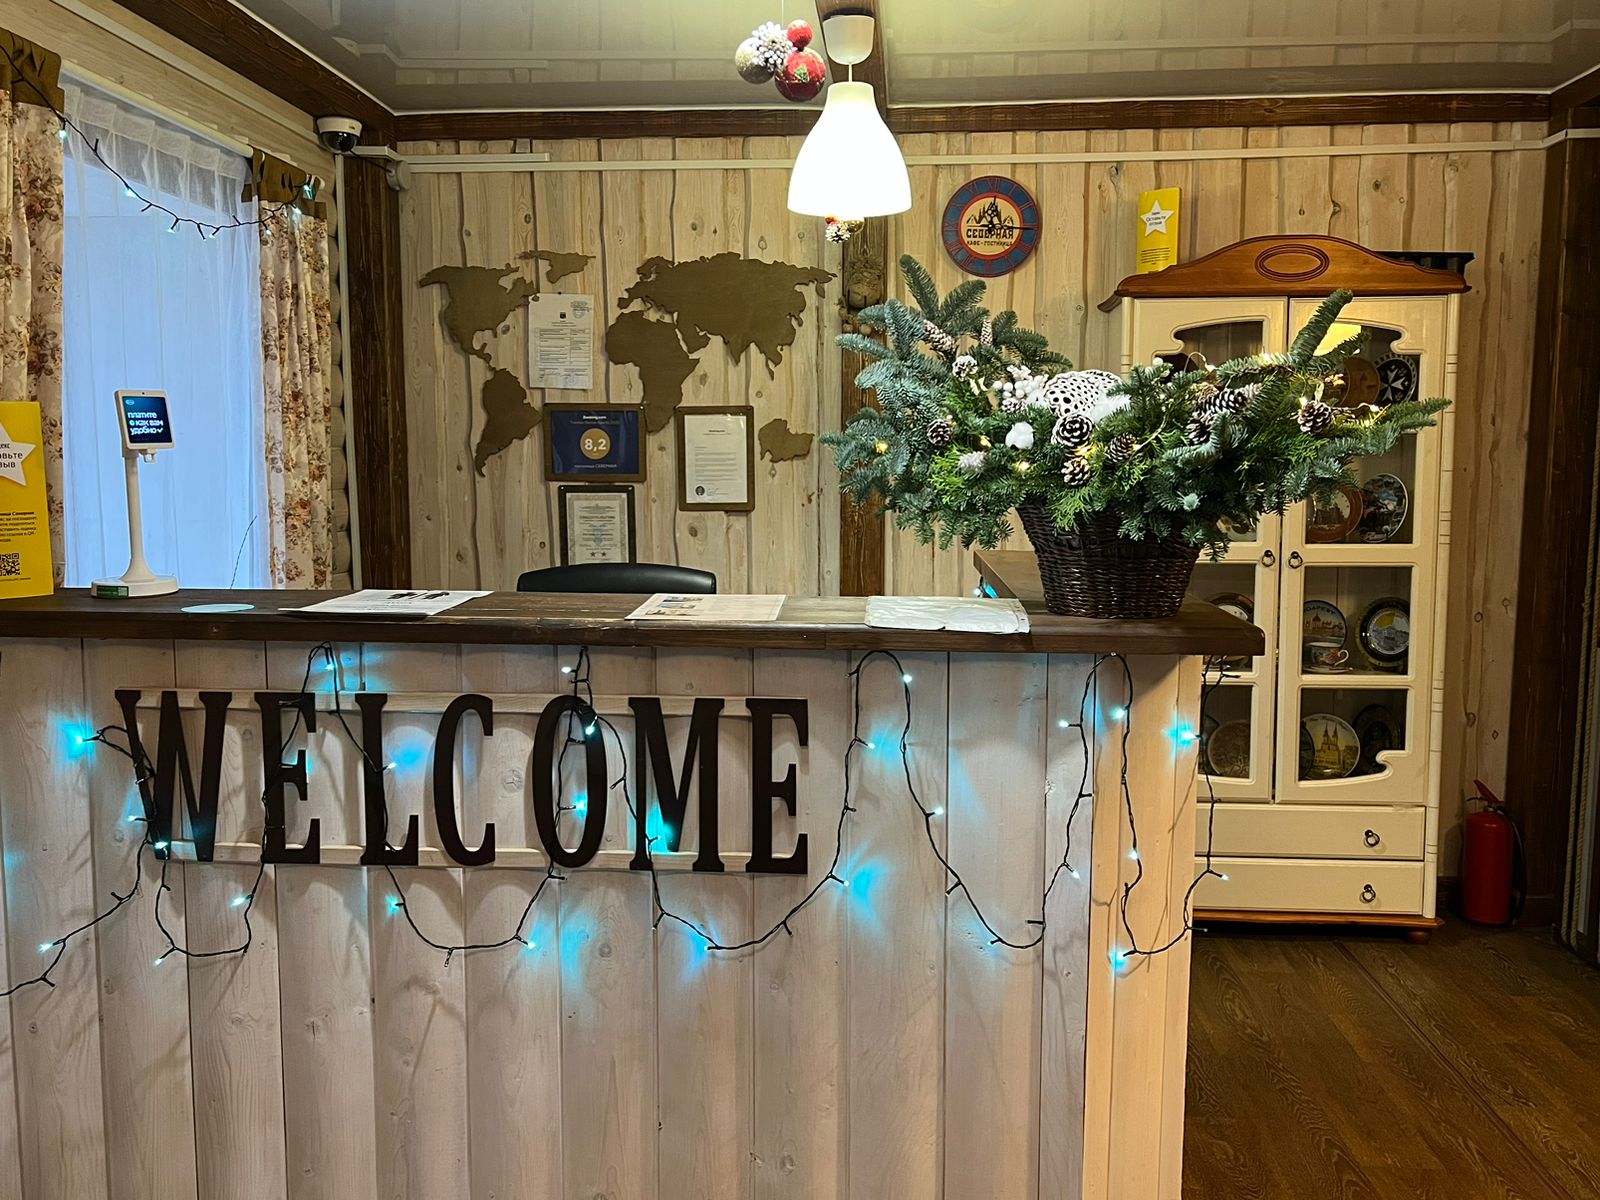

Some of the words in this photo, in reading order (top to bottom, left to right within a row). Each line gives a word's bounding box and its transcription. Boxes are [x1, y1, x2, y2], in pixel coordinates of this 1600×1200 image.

[966, 228, 1014, 239] СЕВЕРНАЯ
[130, 426, 157, 436] удобно
[584, 438, 607, 452] 8,2
[114, 689, 809, 874] WELCOME
